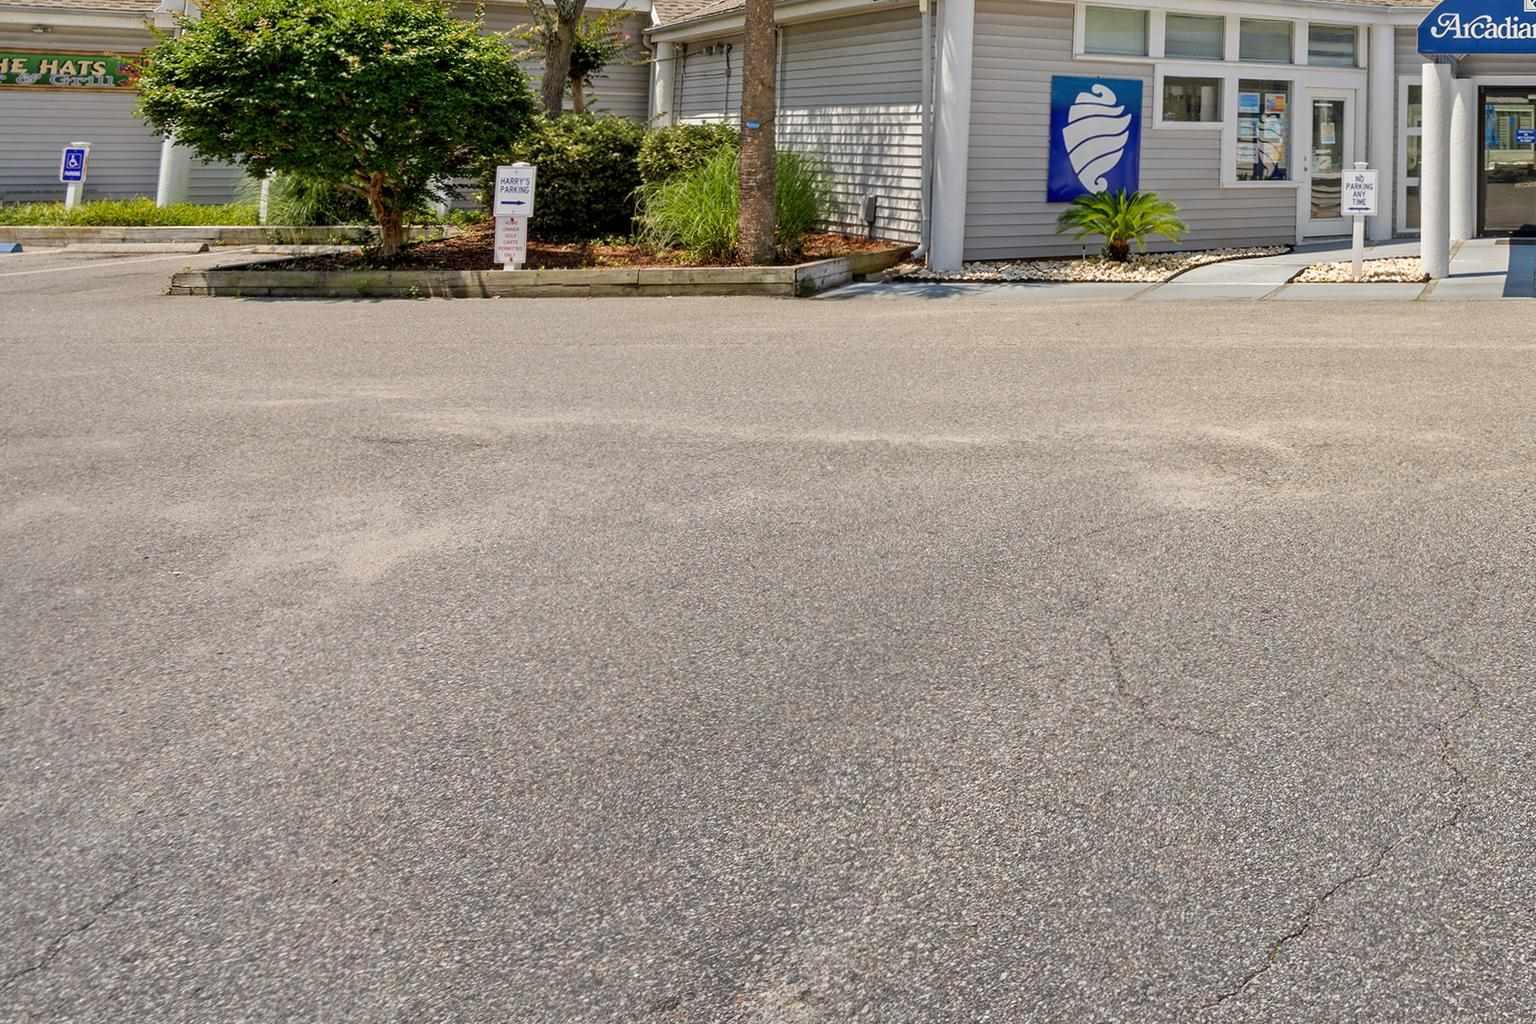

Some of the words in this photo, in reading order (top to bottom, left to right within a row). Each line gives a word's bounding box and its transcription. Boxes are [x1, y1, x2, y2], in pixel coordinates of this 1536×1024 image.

[40, 59, 107, 76] HATS
[49, 73, 115, 87] Grill
[500, 177, 530, 186] HARRY'S
[500, 185, 530, 194] PARKING
[1352, 198, 1367, 206] TIME
